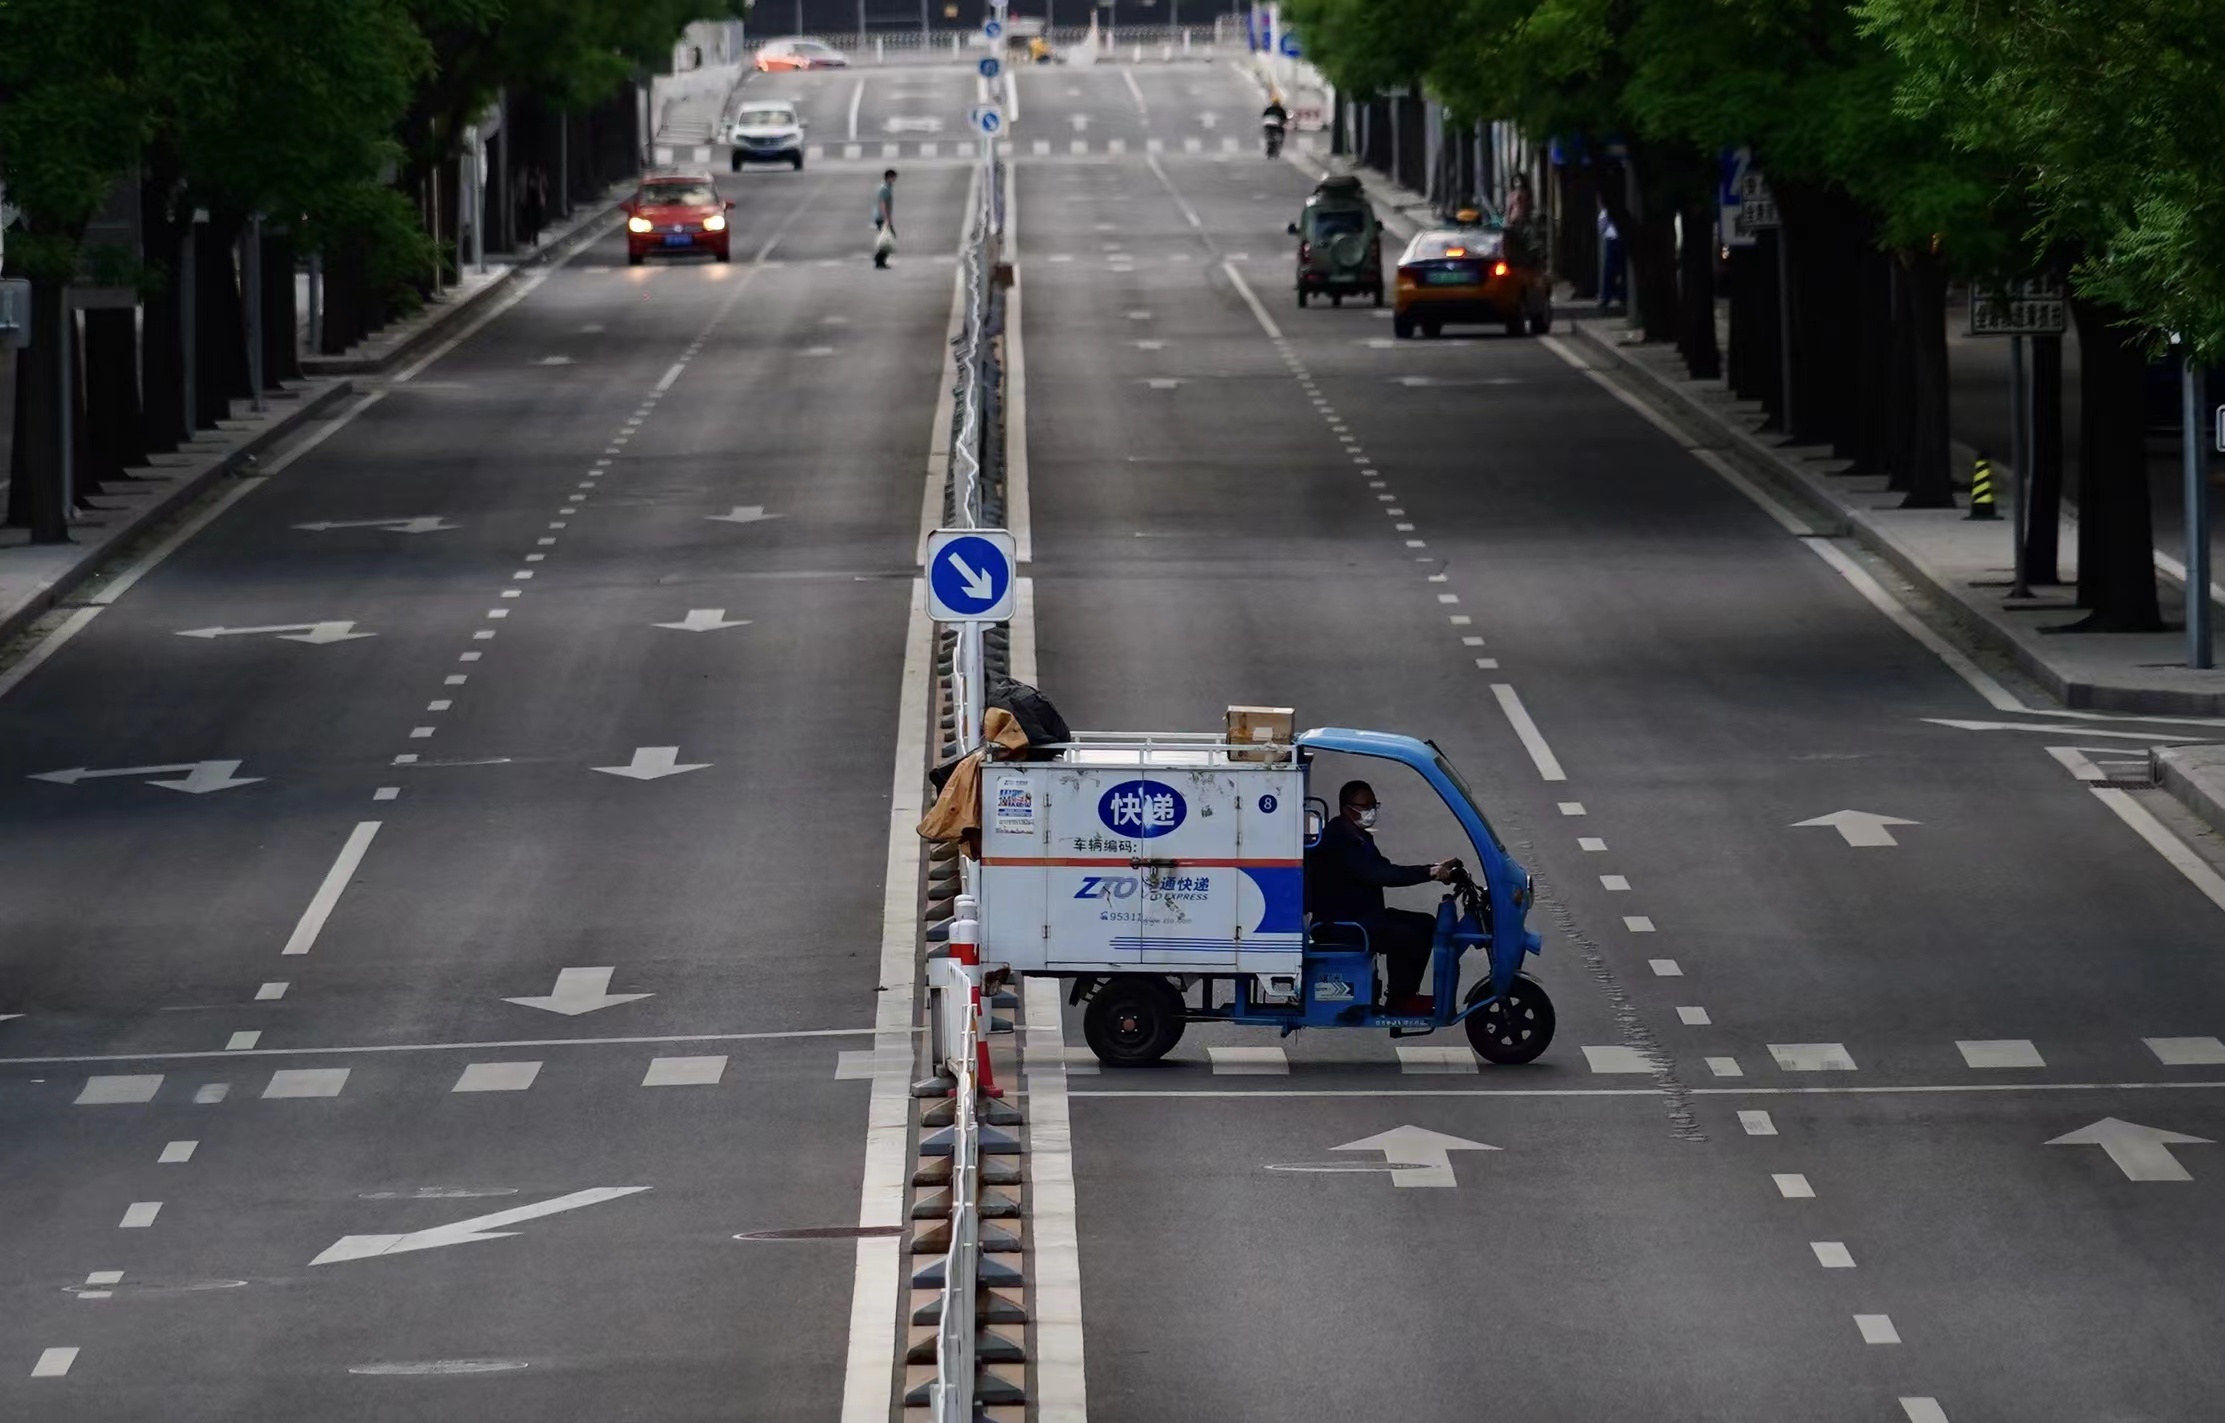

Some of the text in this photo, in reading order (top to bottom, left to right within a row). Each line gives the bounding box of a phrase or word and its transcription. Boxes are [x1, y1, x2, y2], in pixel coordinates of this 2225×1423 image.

[1110, 793, 1175, 826] 快递
[1264, 797, 1272, 810] 8
[1073, 876, 1139, 899] ZTO
[1147, 876, 1210, 892] 通快递
[1164, 893, 1209, 901] EXPRESS
[1110, 911, 1142, 921] 95311
